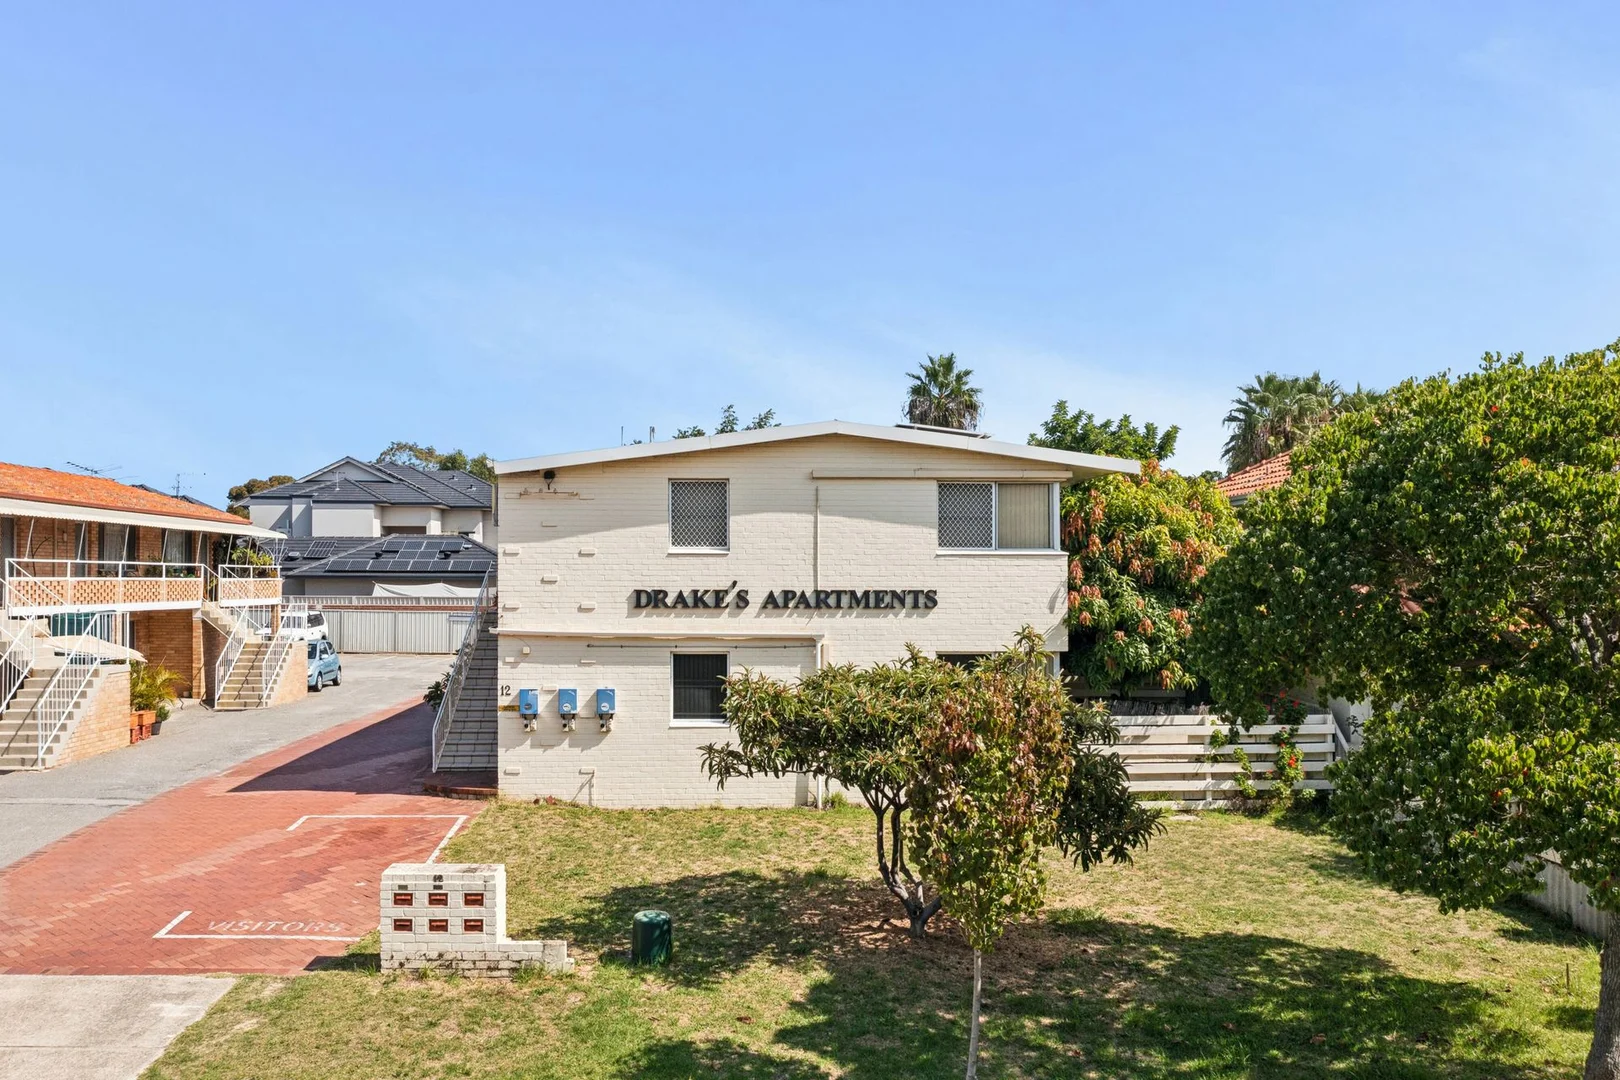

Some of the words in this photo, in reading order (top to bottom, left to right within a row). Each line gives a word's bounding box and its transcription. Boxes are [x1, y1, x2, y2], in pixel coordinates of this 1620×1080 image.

[633, 580, 749, 609] DRAKE'S
[762, 589, 938, 609] APARTMENTS
[500, 685, 511, 696] 12
[208, 920, 345, 932] VISITORS
